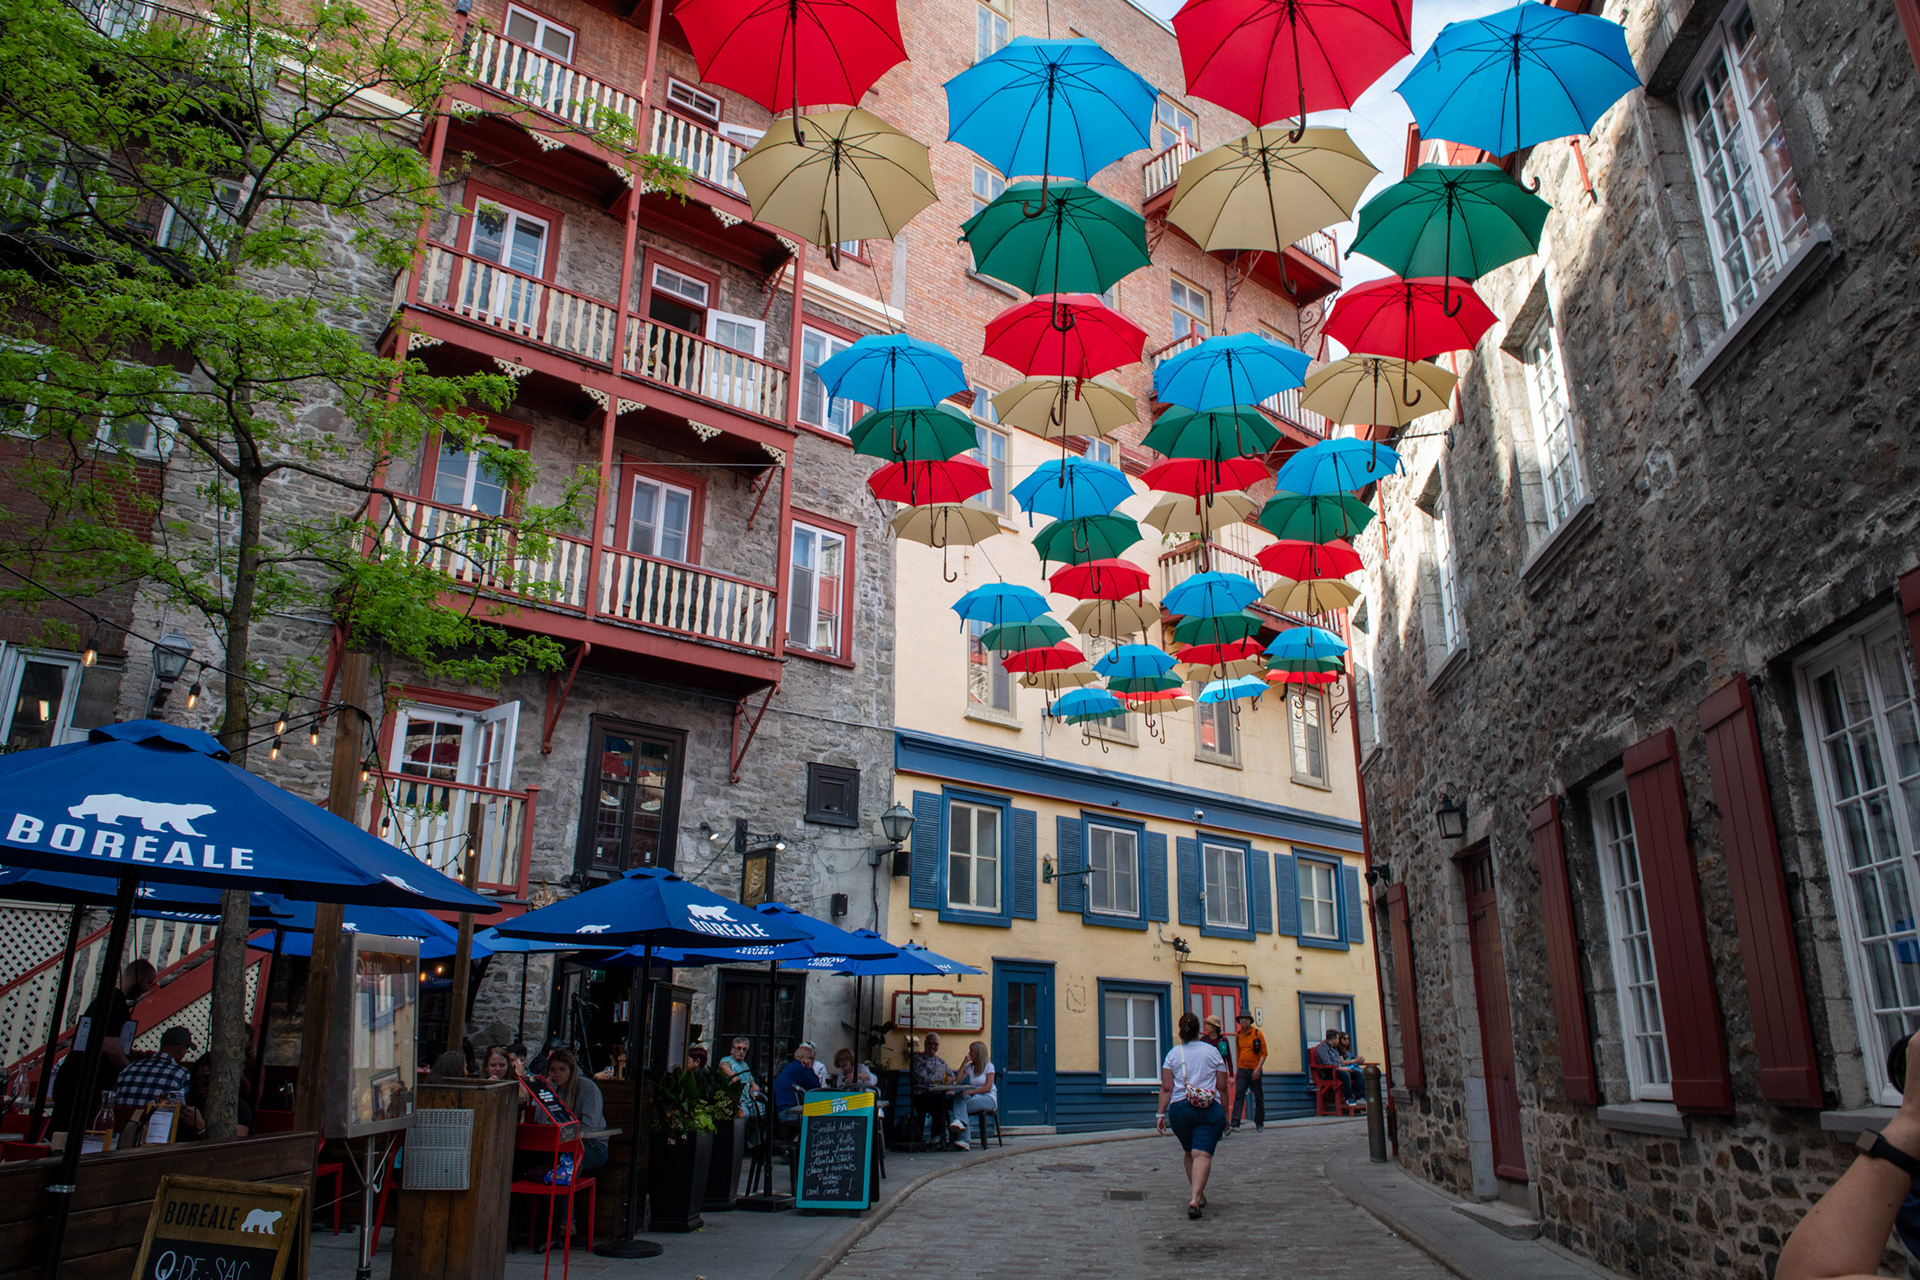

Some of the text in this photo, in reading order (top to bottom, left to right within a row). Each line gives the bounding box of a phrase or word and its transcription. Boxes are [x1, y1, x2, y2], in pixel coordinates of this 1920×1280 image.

[6, 813, 254, 870] BORÉALE
[832, 1104, 847, 1113] IPA
[164, 1200, 240, 1230] BORÉALE
